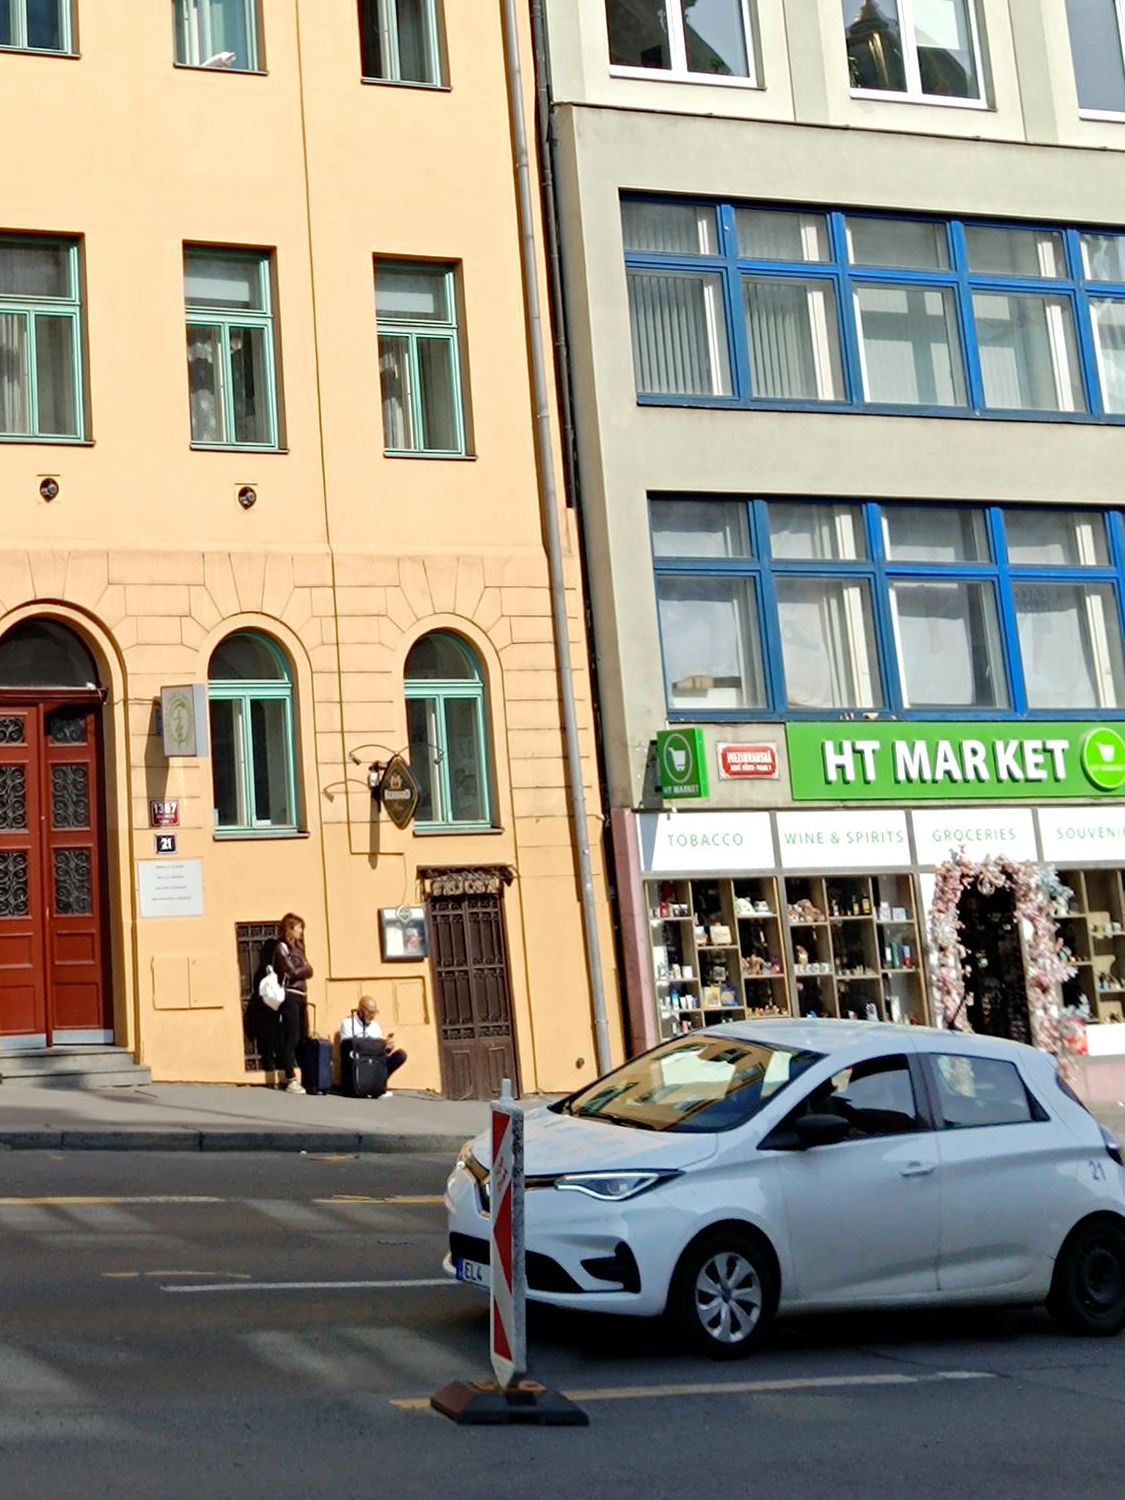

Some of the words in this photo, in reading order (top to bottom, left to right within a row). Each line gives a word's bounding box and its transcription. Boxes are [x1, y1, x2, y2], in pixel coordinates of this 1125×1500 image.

[823, 739, 880, 782] HT
[893, 739, 1070, 782] MARKET
[673, 784, 699, 794] MARKET
[154, 802, 177, 814] 1367
[667, 833, 744, 847] TOBACCO
[784, 831, 824, 845] WINE
[830, 832, 840, 844] &
[846, 830, 904, 844] SPIRITS
[932, 828, 1017, 842] GROCERIES
[160, 837, 172, 850] 21
